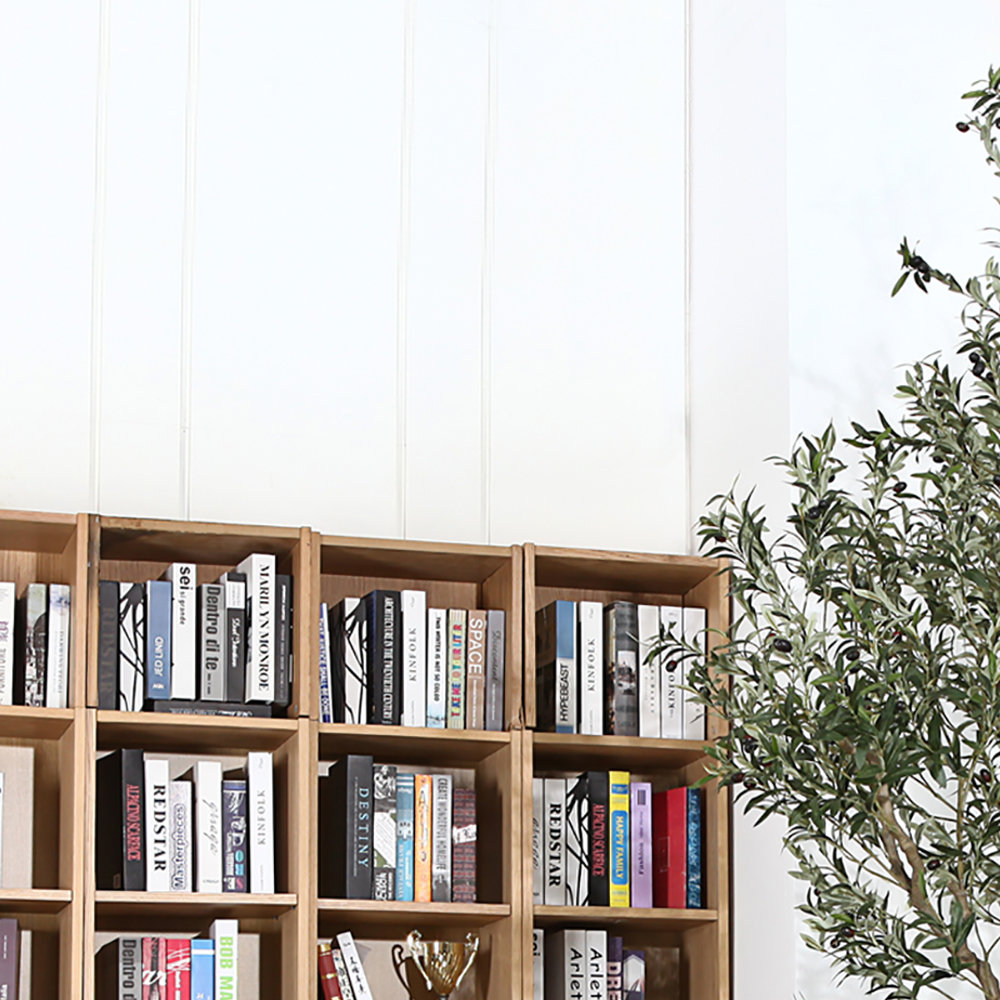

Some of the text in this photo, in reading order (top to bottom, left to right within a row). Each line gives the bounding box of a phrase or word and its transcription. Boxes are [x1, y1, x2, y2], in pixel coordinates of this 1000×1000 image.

[179, 567, 193, 590] sei
[205, 586, 220, 670] Dentro di te
[259, 565, 270, 691] MARILYN MONROE
[408, 627, 416, 681] KINFOLK
[469, 618, 483, 674] SPACE
[560, 664, 569, 721] HYPEBEAST
[257, 790, 265, 845] KINFOLK
[438, 778, 448, 800] CREATE
[154, 785, 165, 871] REDSTAR
[173, 805, 186, 888] Masterpieces
[359, 788, 368, 868] DESTINY
[550, 804, 561, 886] REDSTAR
[616, 816, 624, 879] HAPPY FAMILY
[123, 940, 136, 988] Dentro
[220, 936, 233, 968] BOB
